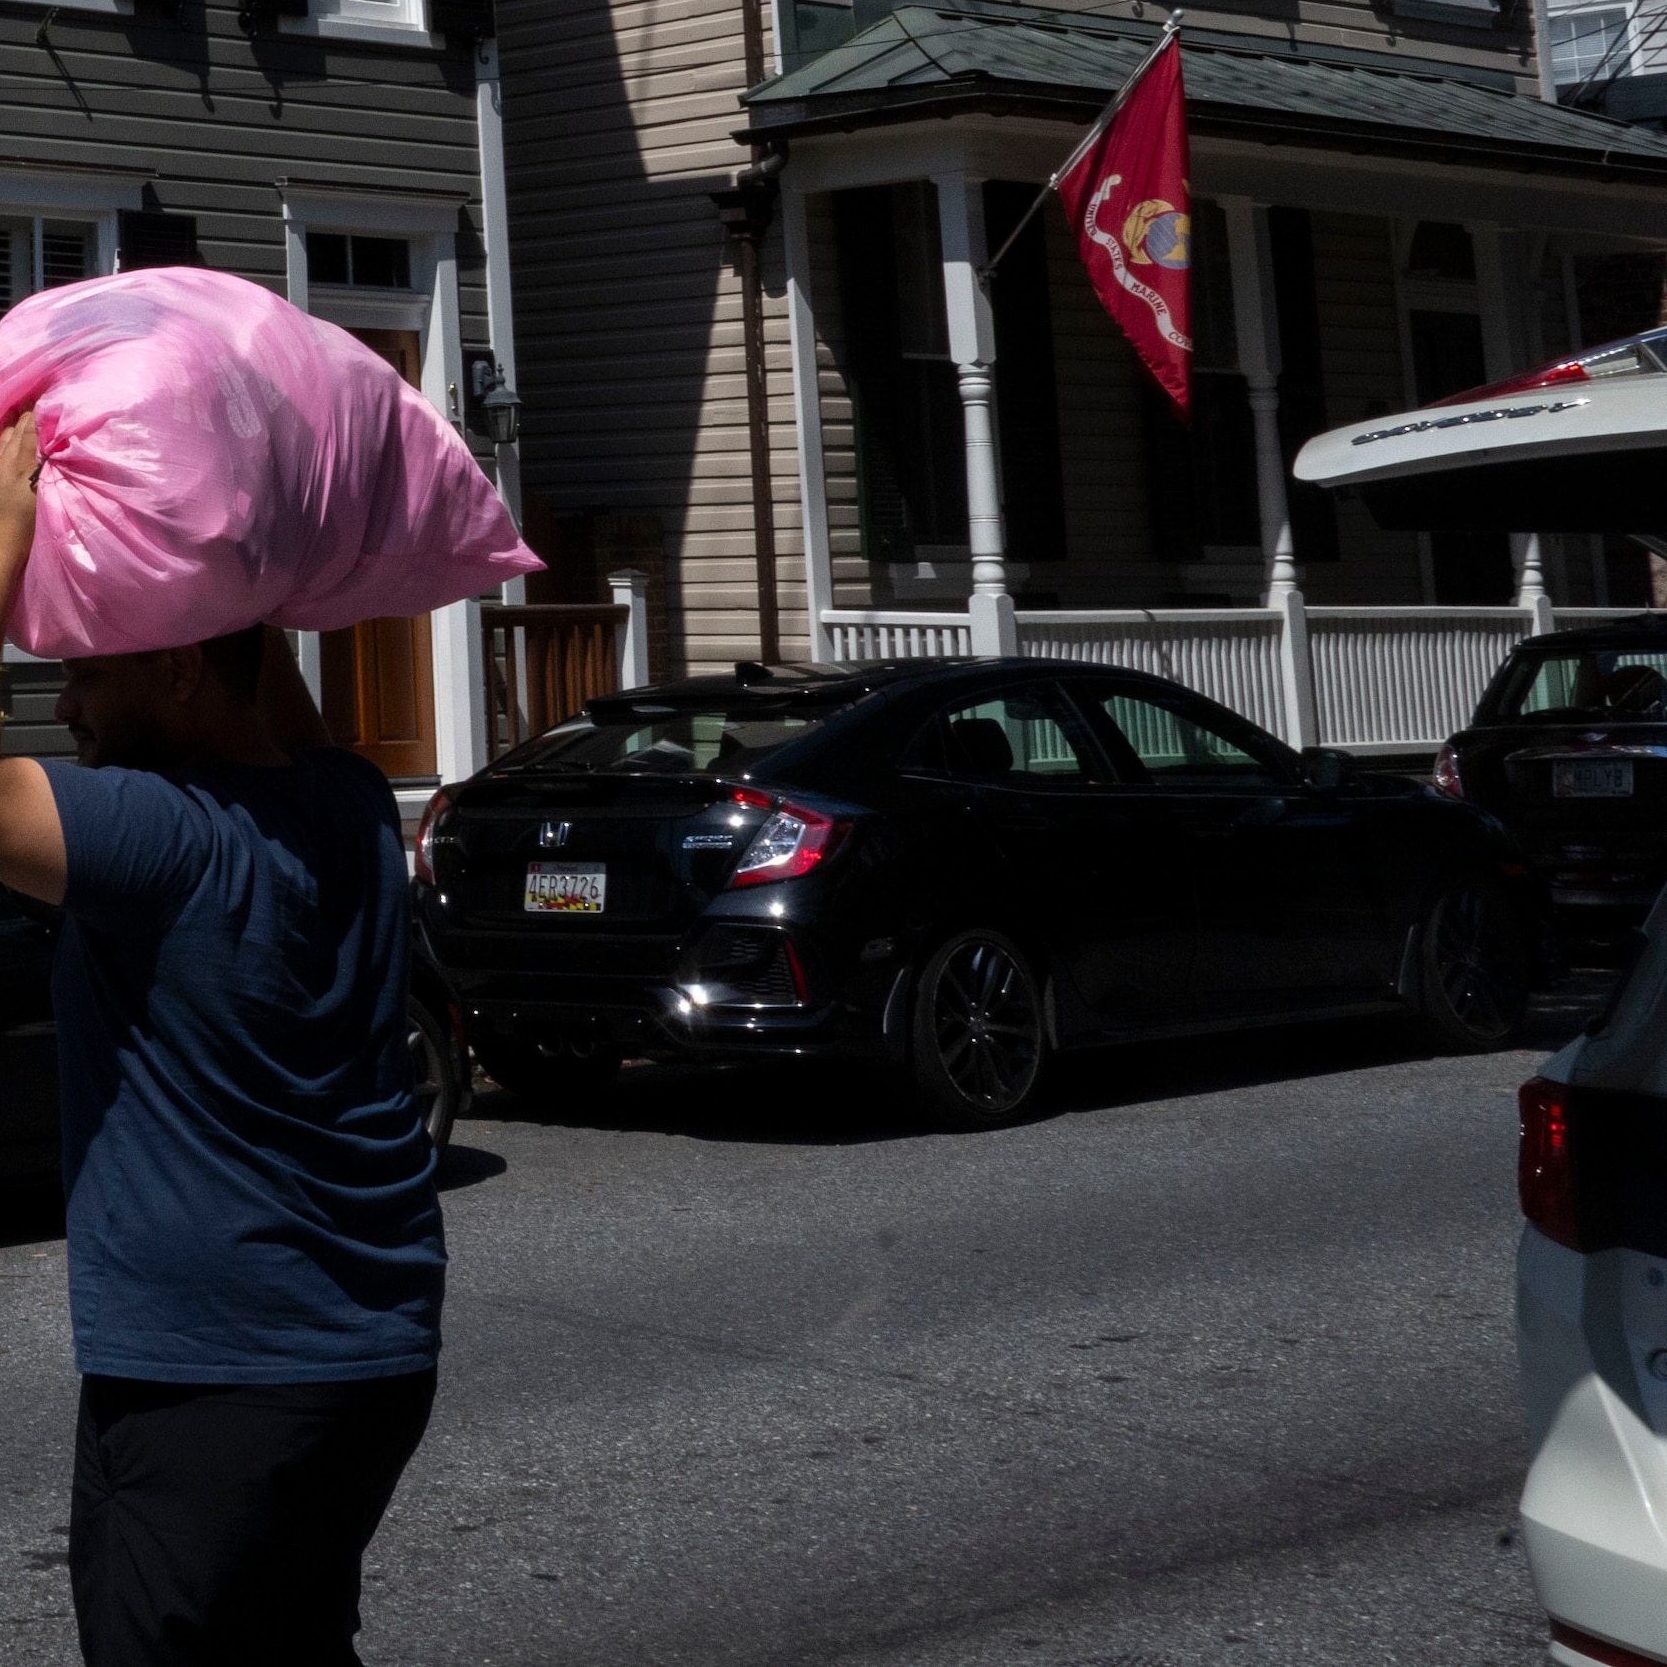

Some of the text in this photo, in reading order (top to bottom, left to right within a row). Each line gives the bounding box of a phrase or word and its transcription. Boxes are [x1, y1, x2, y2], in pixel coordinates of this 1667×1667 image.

[1085, 203, 1098, 236] UNITED
[1105, 237, 1123, 271] STATES
[1129, 281, 1167, 316] MARINE
[528, 874, 600, 902] 4ER3726
